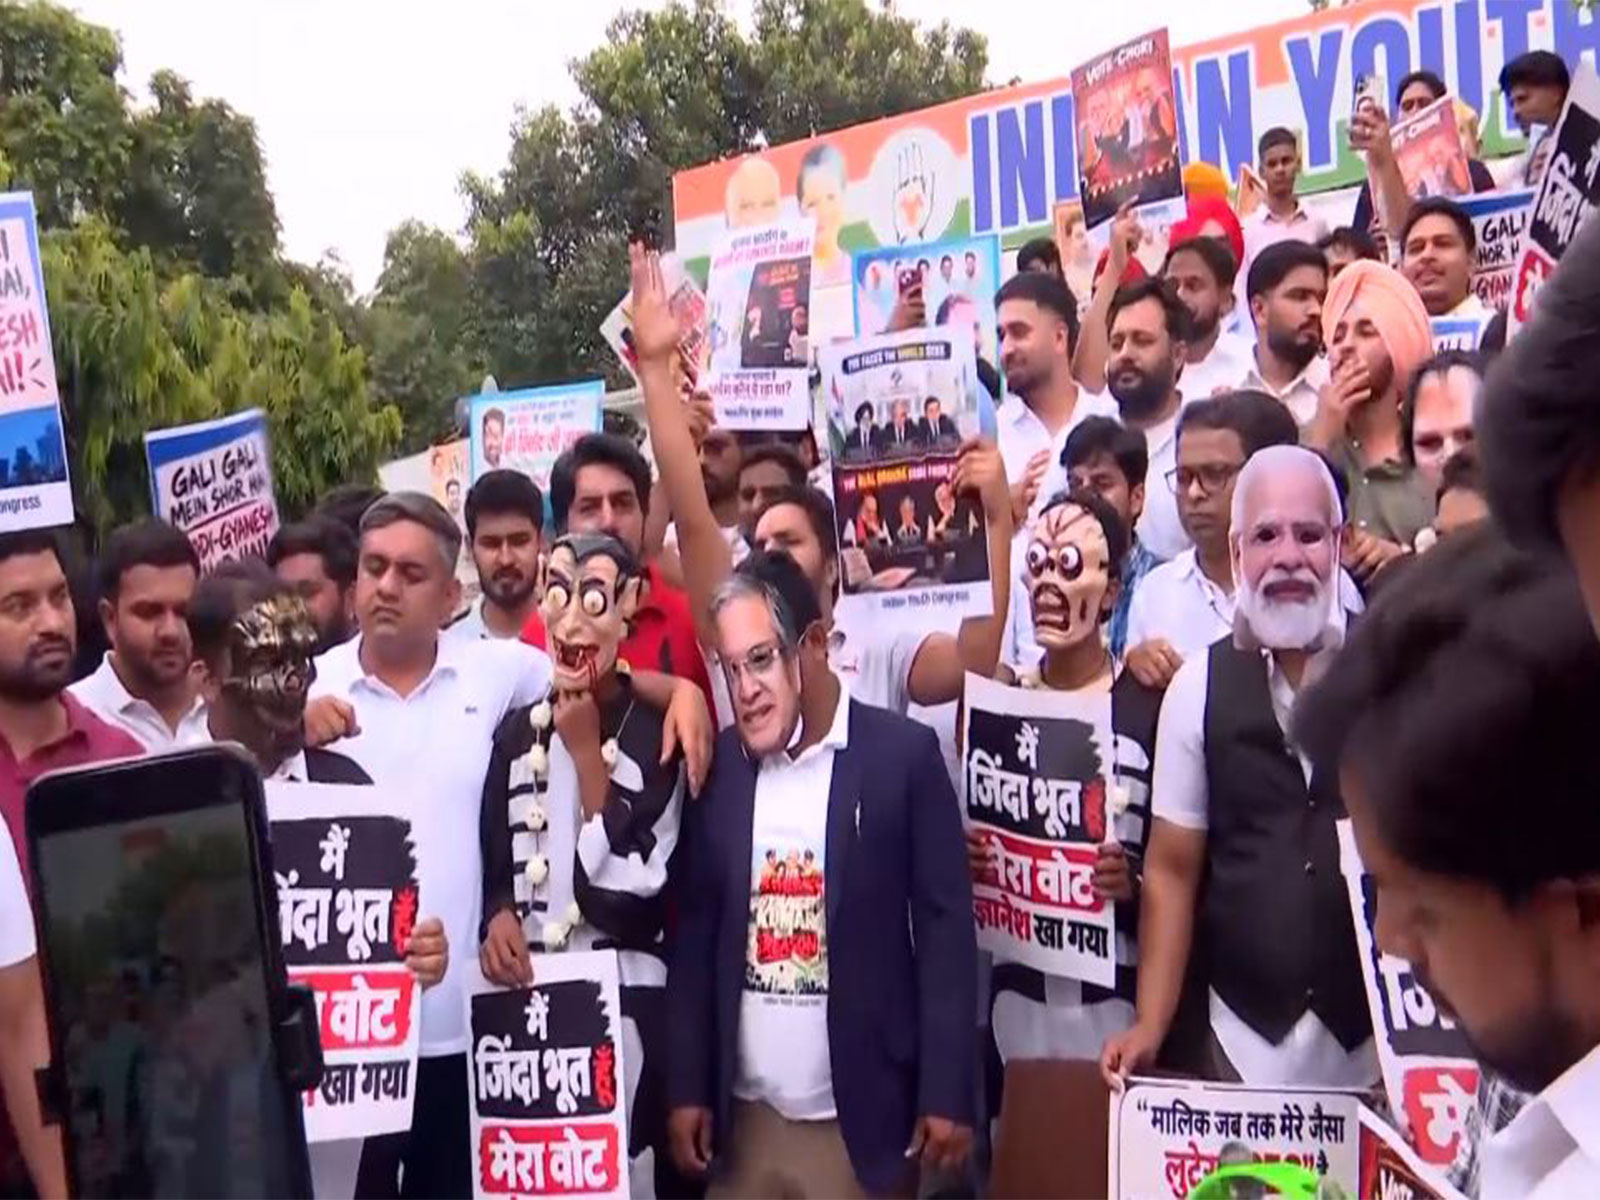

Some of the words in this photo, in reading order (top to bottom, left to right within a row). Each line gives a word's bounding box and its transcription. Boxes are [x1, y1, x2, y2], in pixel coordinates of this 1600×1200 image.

[1478, 245, 1507, 267] HOR
[171, 457, 216, 498] GALI
[170, 495, 207, 527] MEIN
[1015, 720, 1039, 769] मैं
[969, 748, 1028, 822] जिंदा
[1033, 777, 1081, 838] भूत
[319, 823, 350, 880] मैं
[1036, 849, 1096, 906] वोट
[335, 888, 392, 960] भूत
[1033, 913, 1064, 949] खा
[1067, 918, 1108, 958] गया
[330, 974, 402, 1044] वोट
[524, 990, 549, 1040] मैं
[321, 1063, 357, 1105] खा
[361, 1060, 410, 1101] गया
[476, 1034, 539, 1107] जिंदा
[543, 1047, 591, 1114] भूत
[1214, 1110, 1242, 1138] जब
[1247, 1112, 1276, 1141] तक
[1279, 1103, 1304, 1143] मेरे
[1308, 1102, 1345, 1143] जैसा
[488, 1127, 545, 1190] मेरा
[550, 1127, 608, 1189] वोट
